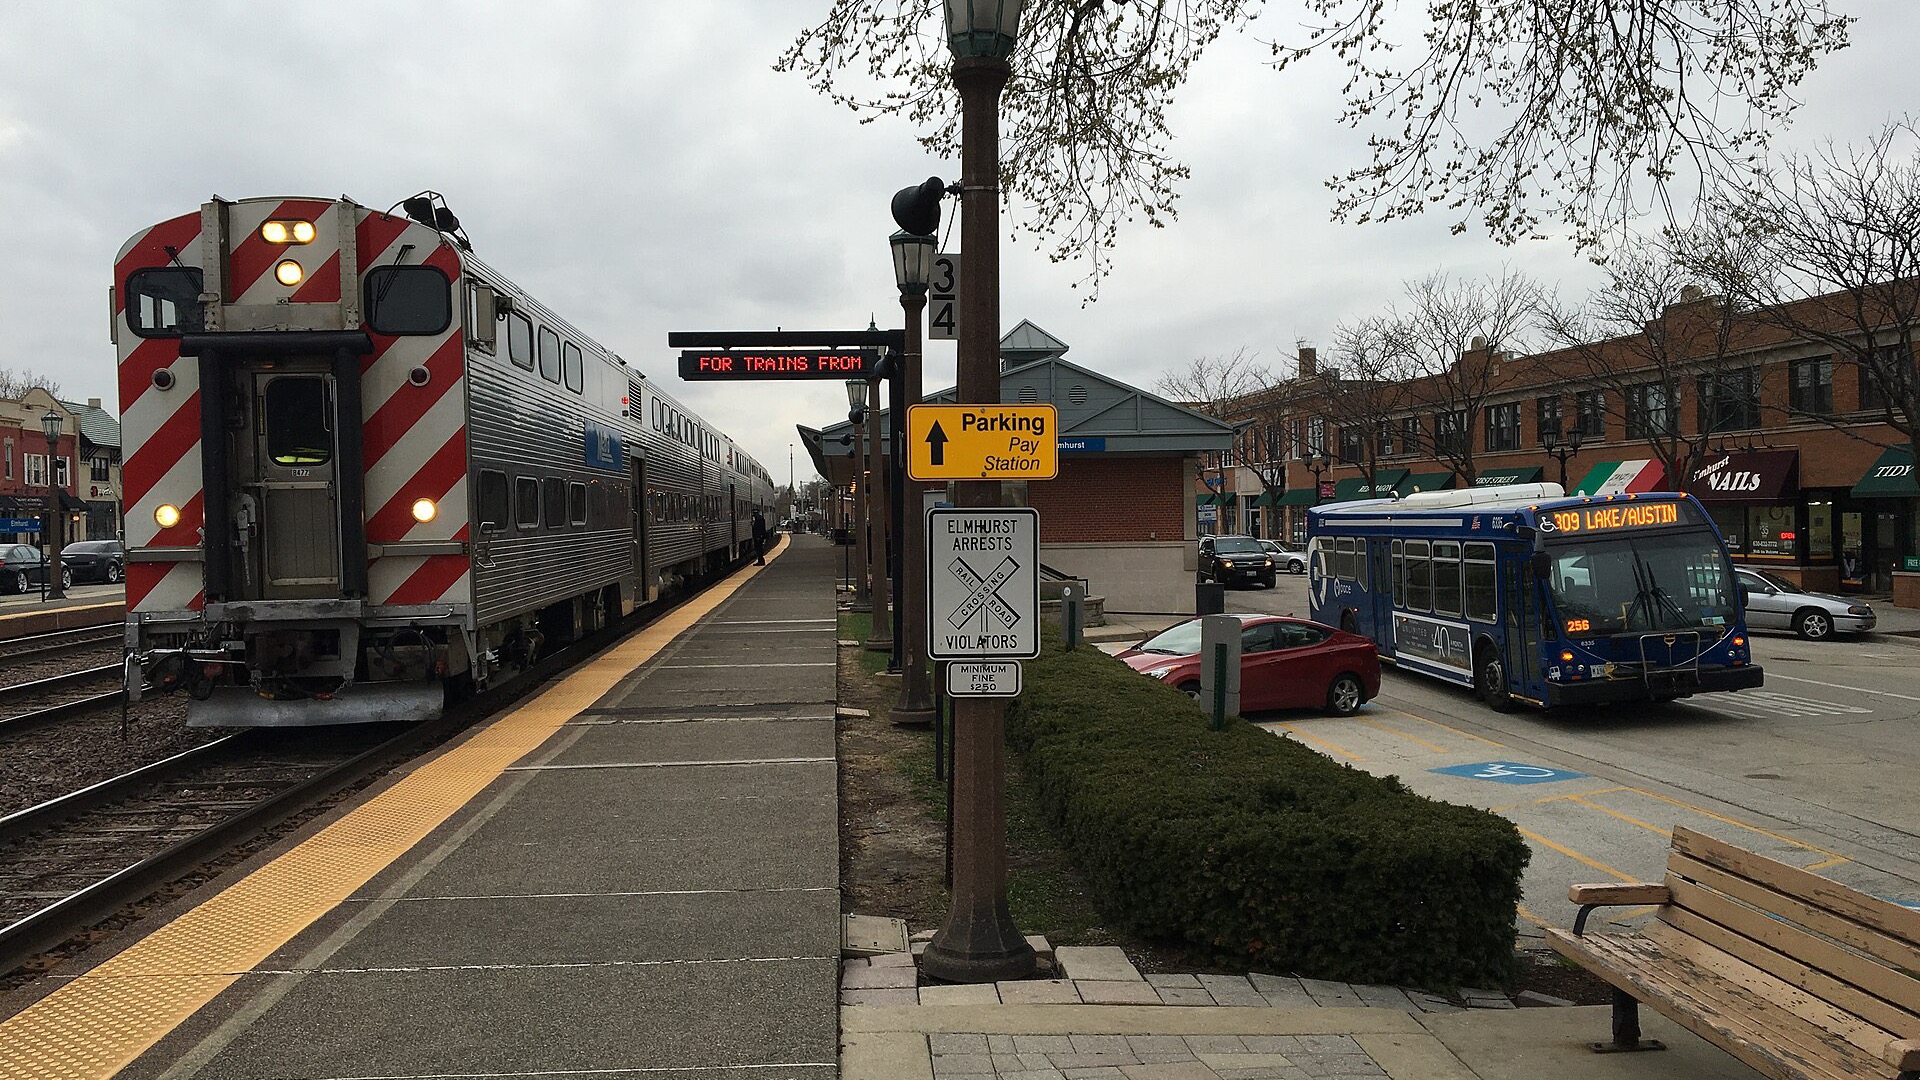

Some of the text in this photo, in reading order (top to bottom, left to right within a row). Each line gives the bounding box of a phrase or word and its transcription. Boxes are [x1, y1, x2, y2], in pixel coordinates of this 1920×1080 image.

[933, 259, 955, 293] 3
[933, 303, 955, 335] 4
[700, 356, 862, 371] FOR TRAINS FROM
[962, 413, 1045, 436] Parking
[1009, 437, 1040, 456] Pay
[1057, 441, 1085, 449] mhurst
[984, 455, 1040, 471] Station
[1491, 475, 1519, 483] STREET
[1874, 465, 1914, 478] TIDY
[1707, 471, 1761, 491] NAILS
[1554, 503, 1678, 532] 309 LAKE/AUSTIN
[947, 519, 1018, 534] ELMHURST
[953, 537, 1013, 551] ARRESTS
[955, 567, 976, 588] RAIL
[960, 571, 1005, 617] CROSSING
[988, 599, 1013, 623] ROAD
[1567, 619, 1590, 632] 256
[946, 634, 1018, 650] VIOLATORS
[960, 664, 1007, 673] MINIMUM
[971, 674, 995, 683] FINE
[970, 683, 997, 692] $250
